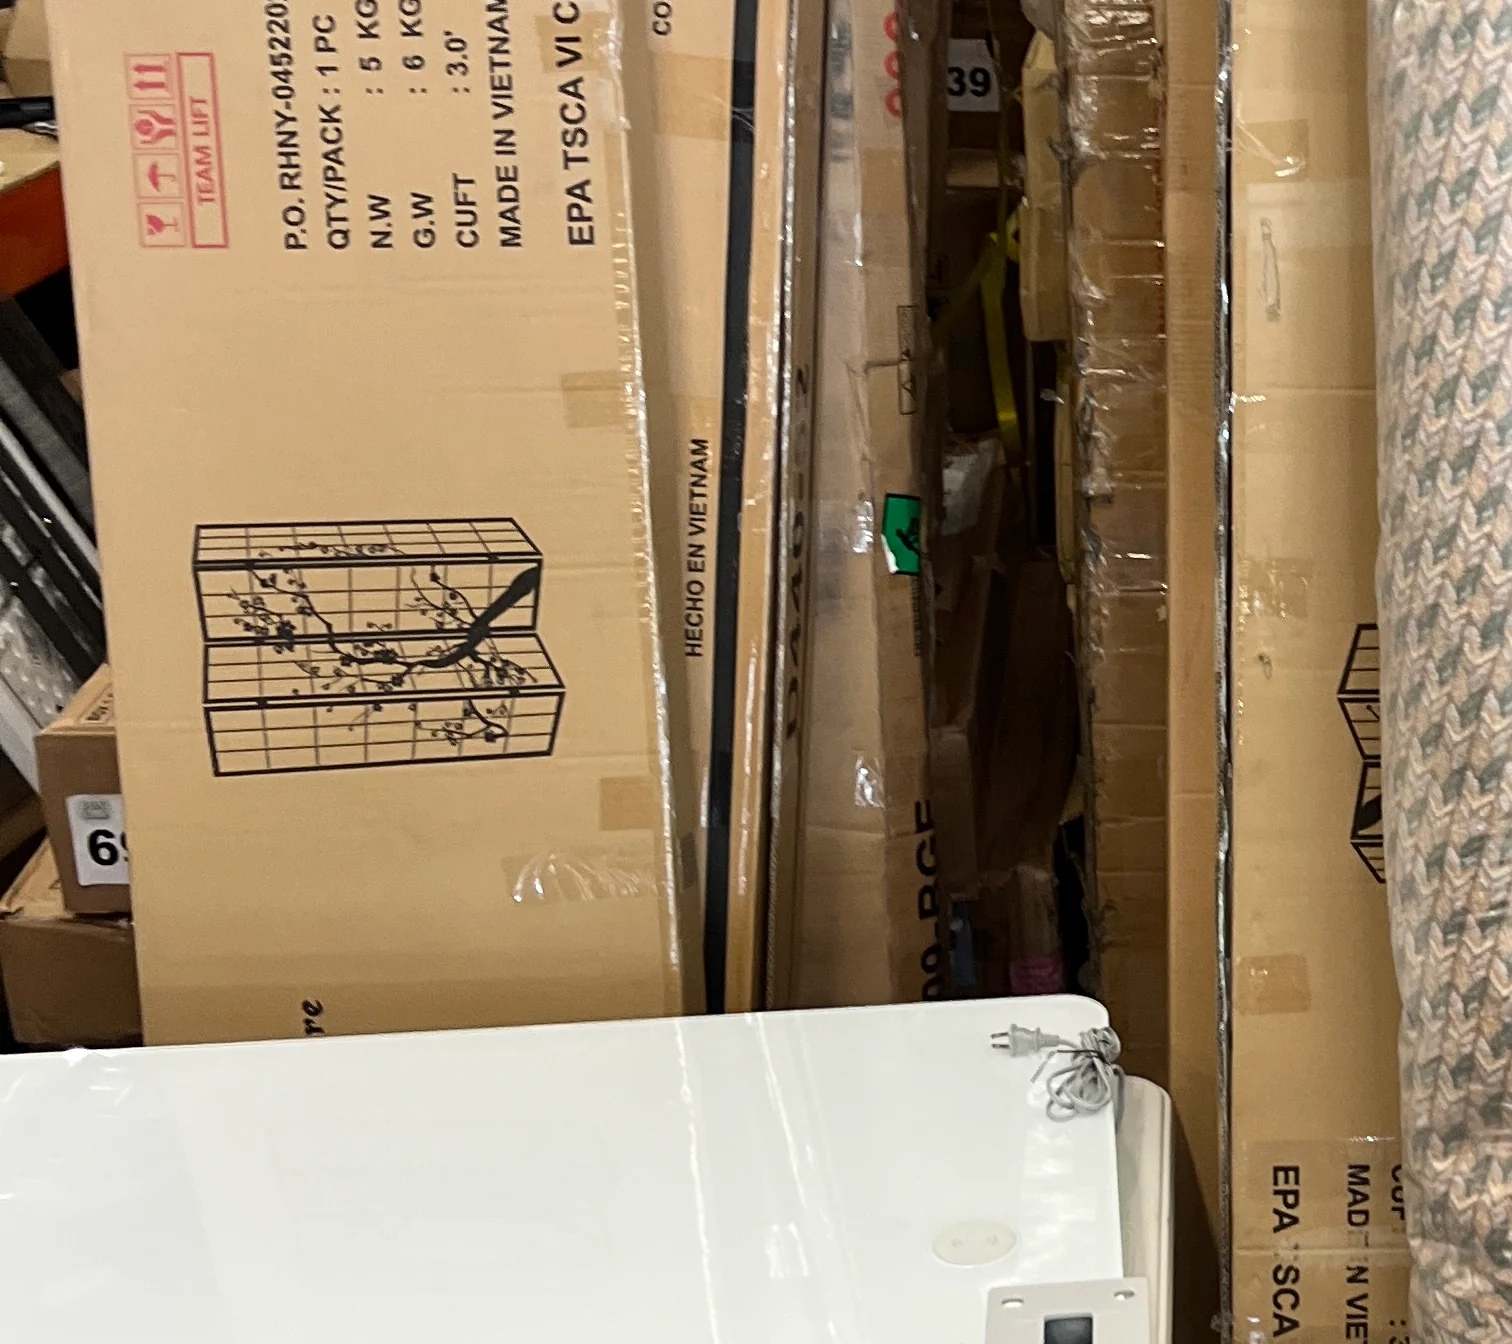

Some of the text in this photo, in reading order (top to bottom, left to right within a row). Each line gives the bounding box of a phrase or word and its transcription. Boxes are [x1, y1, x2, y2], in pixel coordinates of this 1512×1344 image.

[312, 14, 338, 53] PC
[555, 36, 584, 68] VI
[316, 65, 339, 76] 1
[359, 56, 383, 72] 5
[401, 55, 426, 71] 6
[189, 96, 215, 205] TEAM LIFT
[494, 128, 516, 156] IN
[557, 76, 591, 170] TSCA
[318, 104, 350, 249] QTY/PACK
[282, 198, 308, 250] P.O.
[367, 194, 394, 249] N.W
[410, 192, 437, 248] G.W
[452, 173, 480, 248] CUFT
[495, 165, 522, 247] MADE
[565, 178, 595, 246] EPA
[684, 438, 710, 658] HECHO EN VIETNAM
[88, 829, 128, 866] 6
[1272, 1165, 1300, 1235] EPA
[1272, 1239, 1300, 1338] SCA
